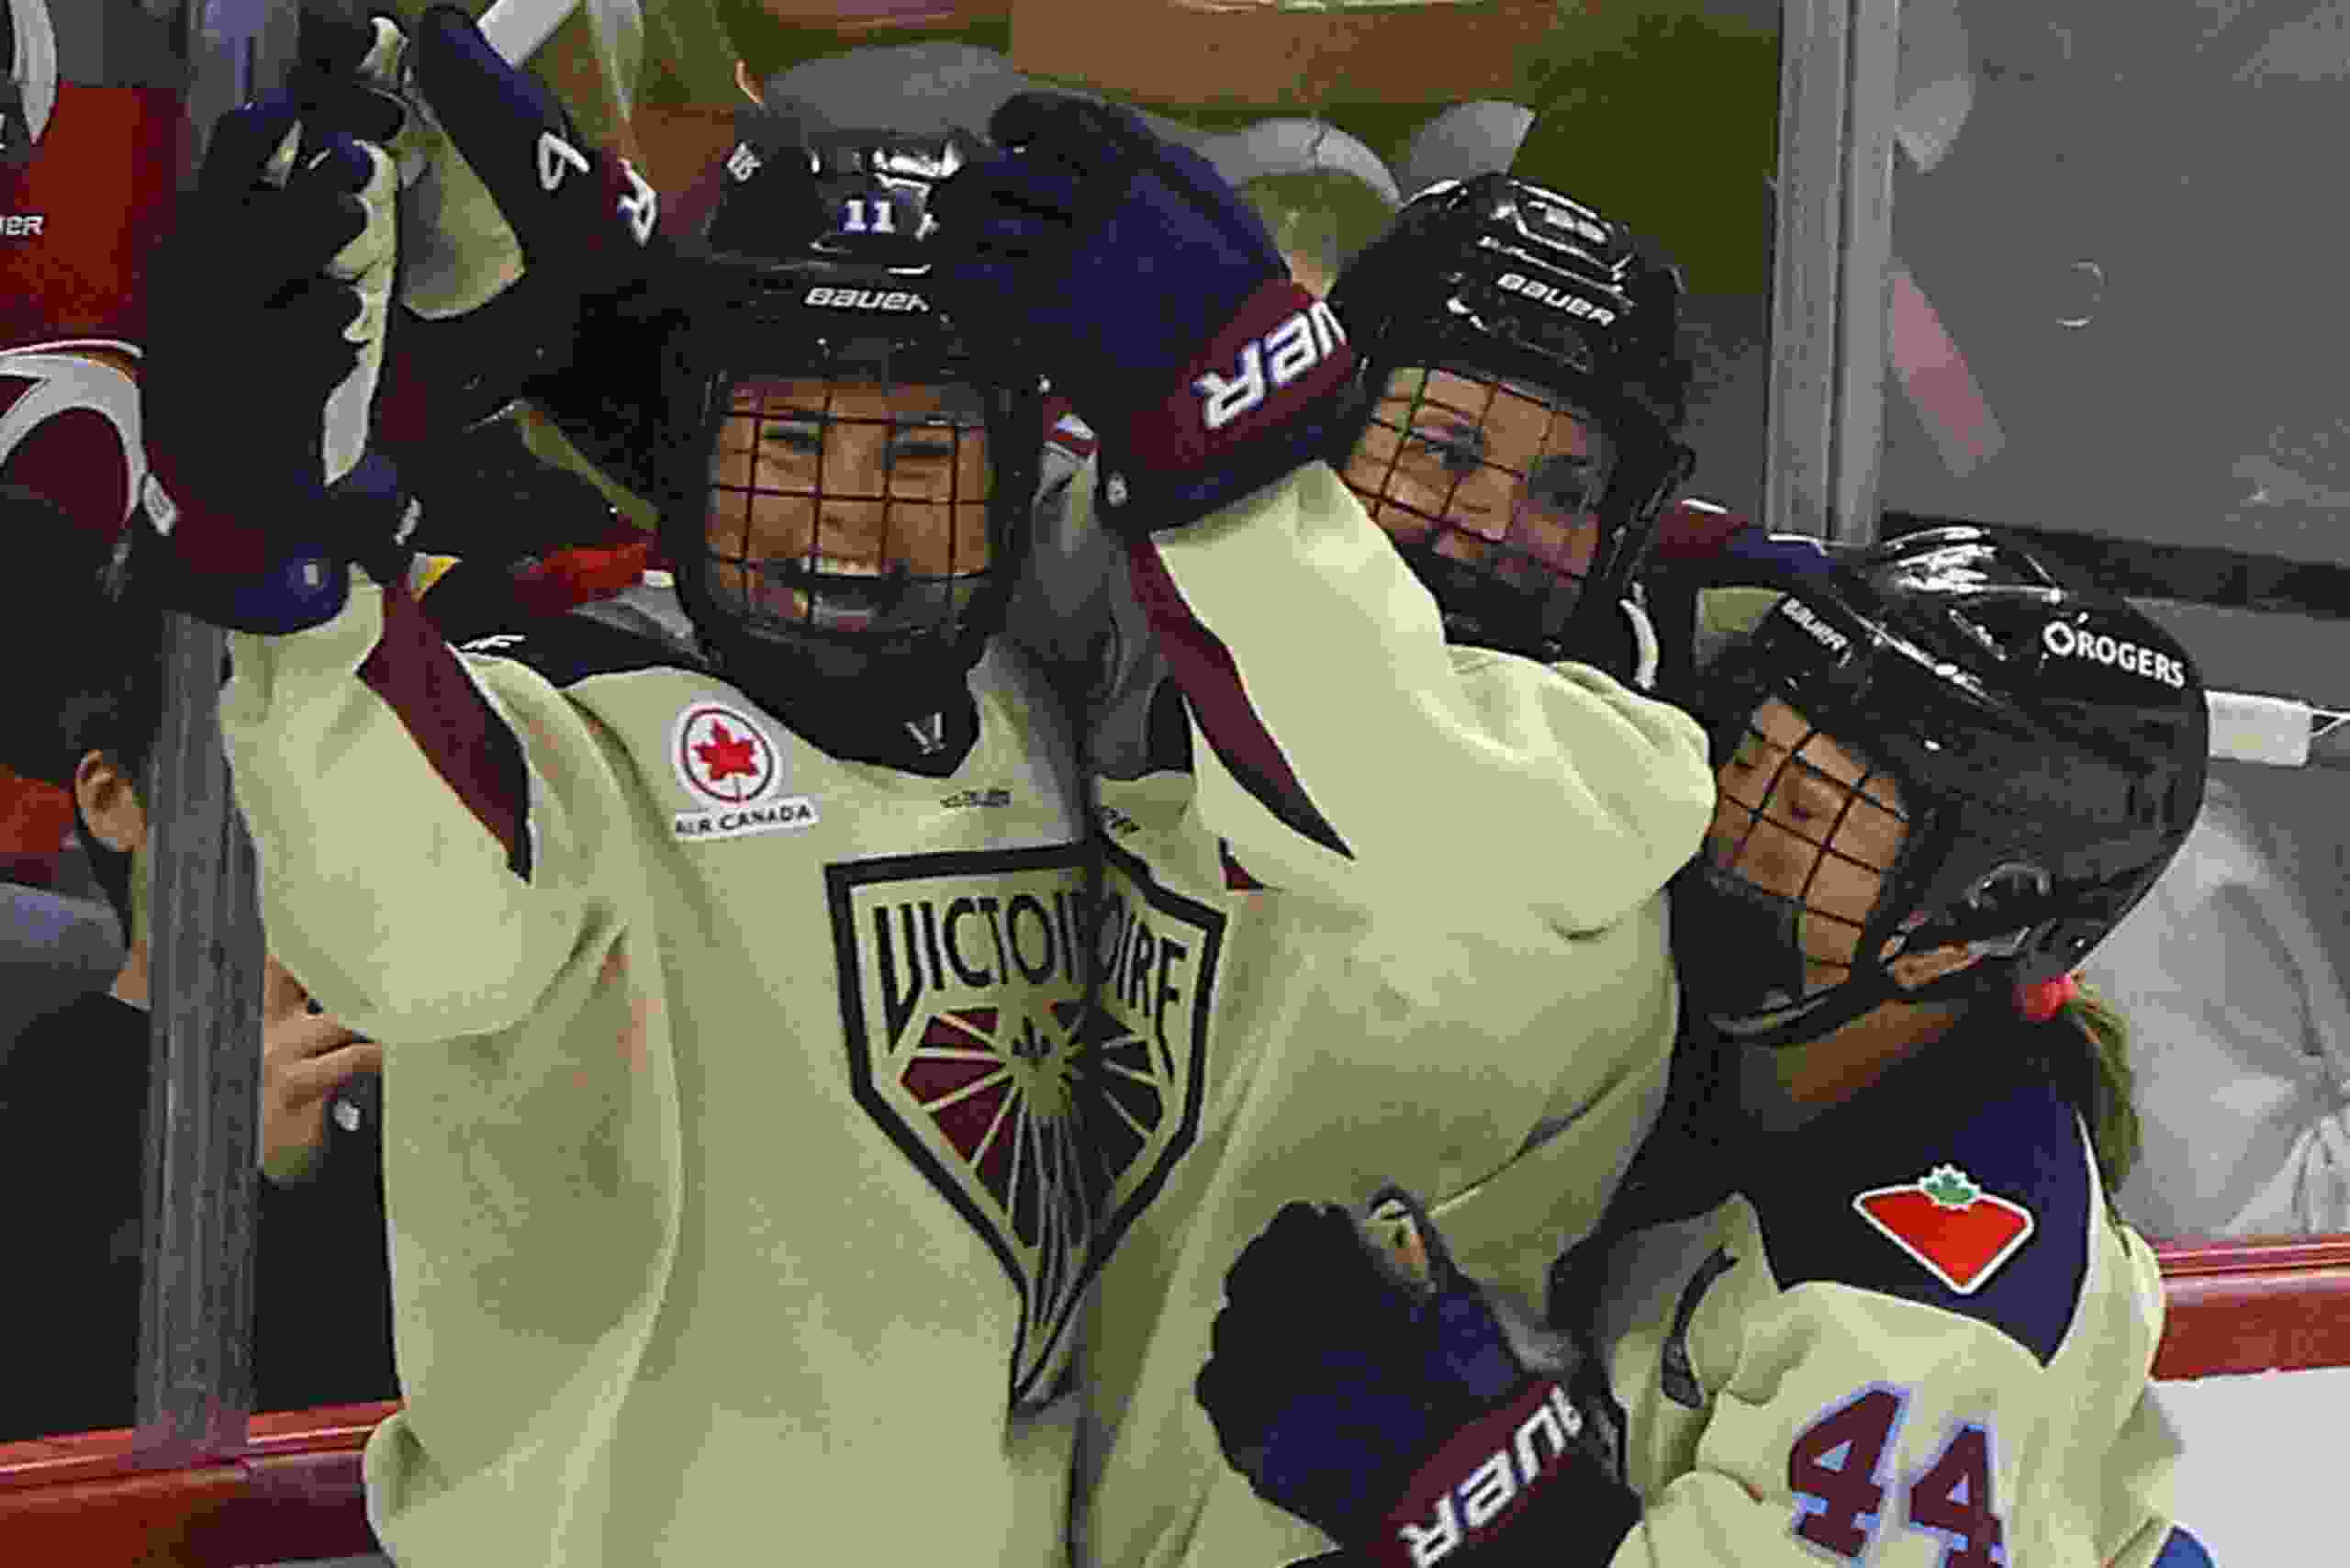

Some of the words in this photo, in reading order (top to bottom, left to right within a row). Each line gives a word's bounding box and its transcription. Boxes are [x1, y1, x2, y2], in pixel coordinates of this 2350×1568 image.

[844, 198, 896, 234] 11
[1195, 299, 1348, 430] UER
[2076, 629, 2186, 689] ROGERS
[675, 817, 713, 834] AIR
[719, 804, 811, 831] CANADA
[1788, 1388, 2005, 1568] 44
